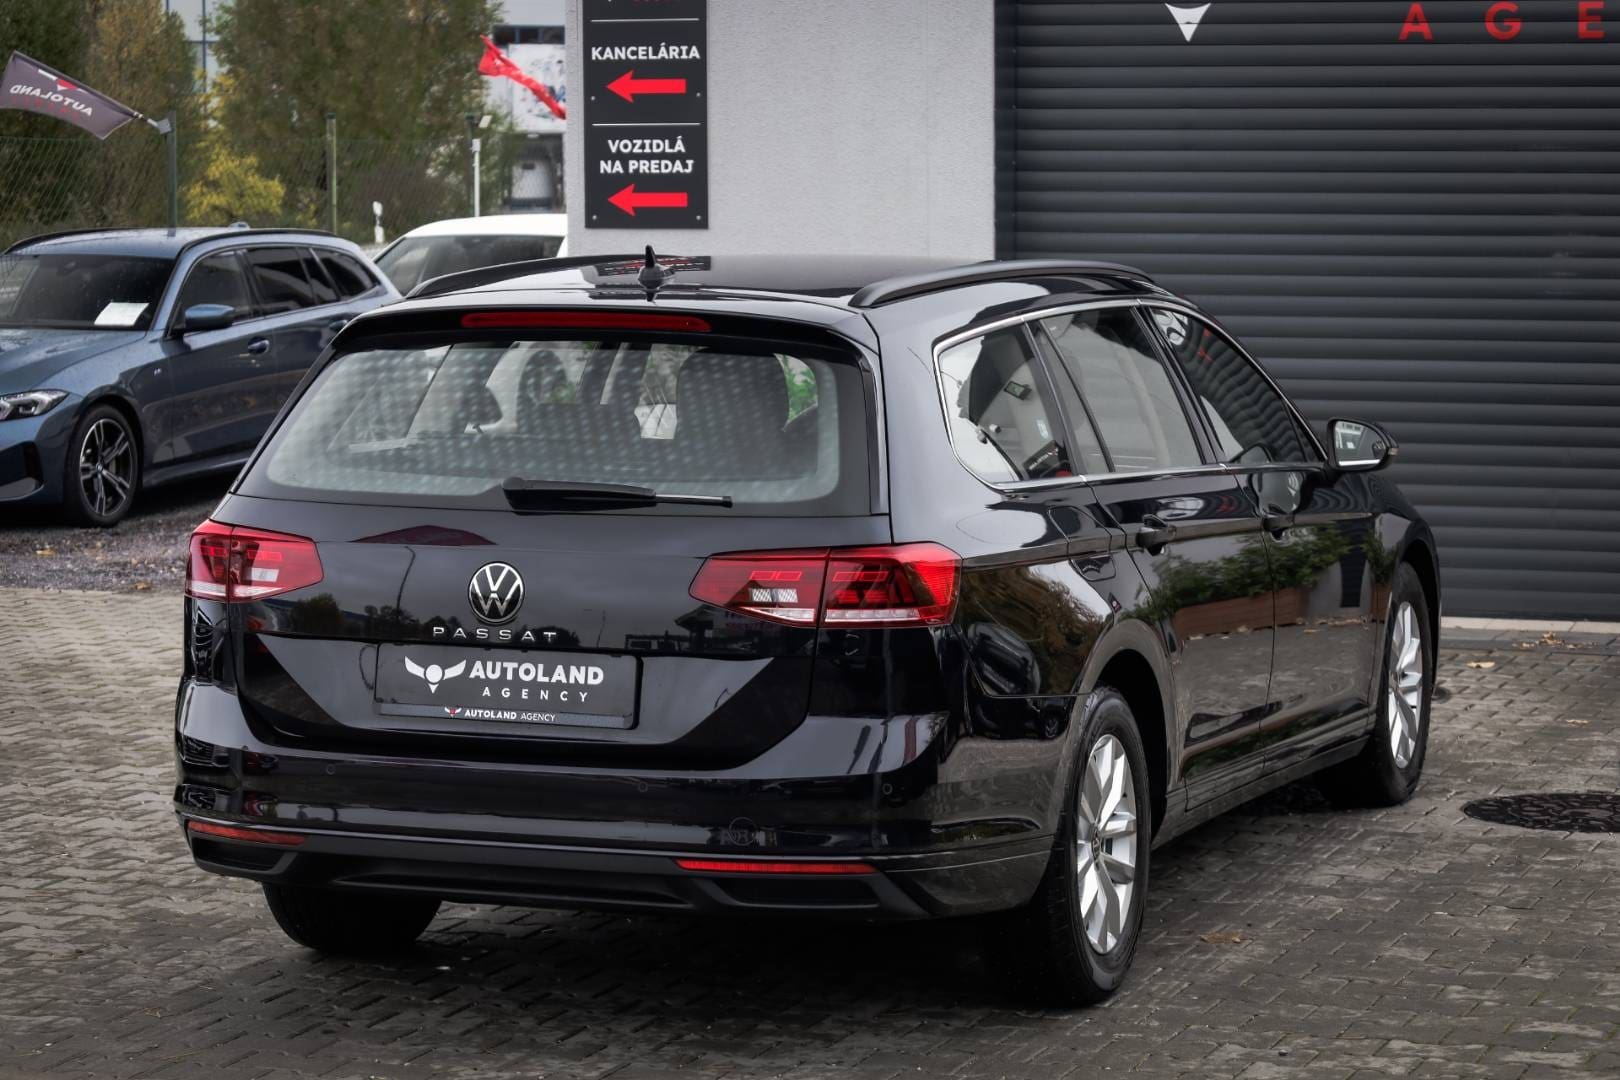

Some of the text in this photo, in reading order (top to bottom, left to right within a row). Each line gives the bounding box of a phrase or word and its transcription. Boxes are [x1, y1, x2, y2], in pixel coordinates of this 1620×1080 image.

[591, 42, 700, 60] KANCELÁRIA
[607, 136, 685, 153] VOZIDLÁ
[600, 159, 694, 174] NA PREDAJ
[432, 626, 557, 642] PASSAT
[469, 660, 604, 686] AUTOLAND
[482, 686, 588, 703] AGENCY
[464, 709, 556, 722] AUTOLAND AGENCY
